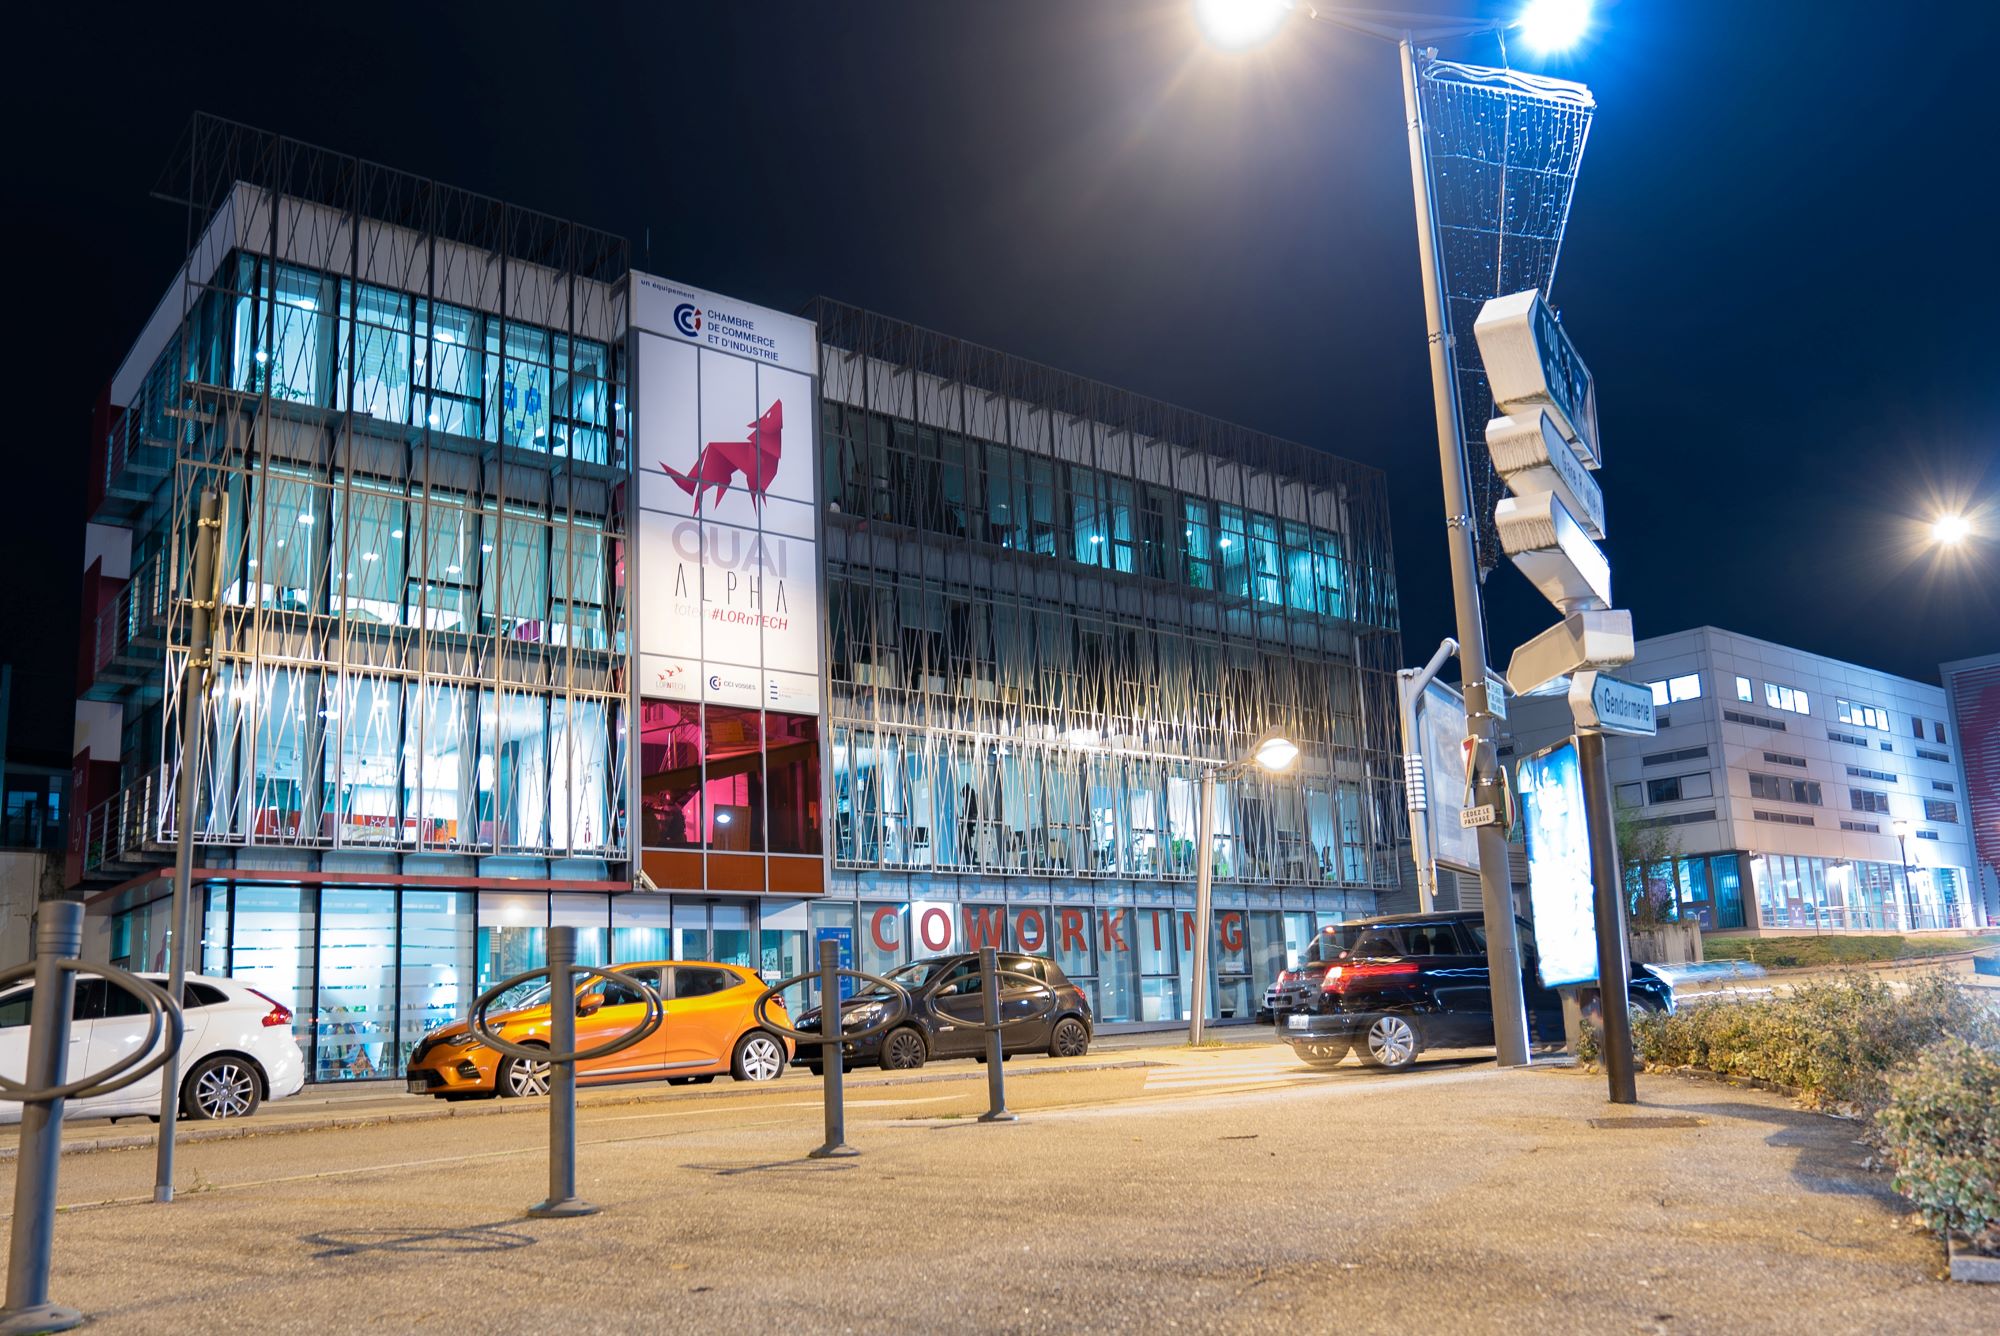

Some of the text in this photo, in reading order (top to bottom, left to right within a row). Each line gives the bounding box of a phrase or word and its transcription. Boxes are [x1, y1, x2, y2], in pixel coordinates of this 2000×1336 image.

[640, 279, 695, 300] un équipement
[707, 309, 754, 331] CHAMBRE
[707, 322, 775, 349] DE COMMERCE
[707, 334, 779, 361] ET D'INDUSTRIE
[671, 521, 787, 578] QUAI
[711, 608, 788, 631] #LORnTECH
[1604, 687, 1650, 722] Gendarmerie
[1464, 814, 1491, 825] PASSAGE
